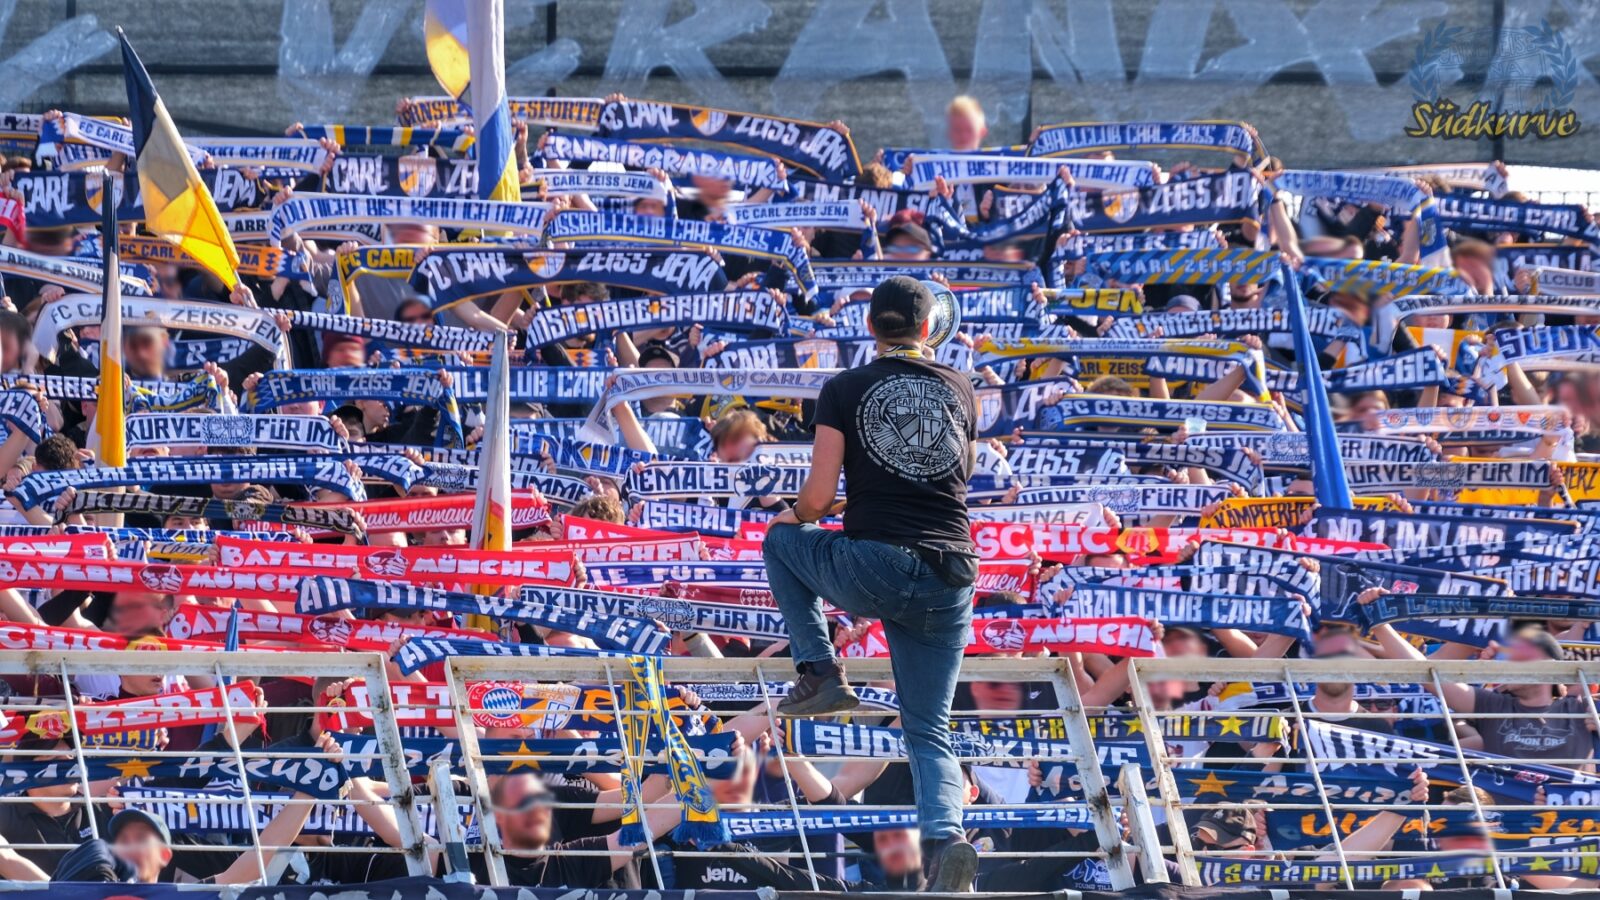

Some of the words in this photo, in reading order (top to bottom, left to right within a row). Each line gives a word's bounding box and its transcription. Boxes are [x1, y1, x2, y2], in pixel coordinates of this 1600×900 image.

[95, 126, 126, 143] CARL
[623, 102, 680, 133] CARL
[735, 115, 800, 147] ZEISS
[1126, 123, 1166, 146] CARL
[1172, 123, 1215, 146] ZEISS
[333, 156, 389, 195] CARL
[446, 161, 479, 194] ZEI
[553, 175, 582, 187] CARL
[586, 175, 619, 188] ZEISS
[624, 177, 654, 190] JENA
[1304, 173, 1338, 191] CARL
[1341, 174, 1384, 193] ZEISS
[17, 173, 75, 218] CARL
[309, 199, 361, 220] NICHT
[366, 199, 401, 218] BIST
[411, 201, 460, 221] KANN
[495, 204, 548, 229] NICHT
[736, 208, 750, 220] FC
[752, 207, 782, 220] CARL
[784, 205, 817, 218] ZEISS
[819, 204, 850, 217] JENA
[1438, 197, 1521, 223] LLCLUB
[1525, 207, 1580, 231] CARL
[672, 216, 716, 245] CARL
[722, 223, 773, 251] ZEISS
[141, 243, 176, 258] CARL
[366, 249, 416, 268] CARL
[453, 251, 515, 283] CARL
[577, 252, 652, 275] ZEISS
[652, 252, 719, 292] JENA
[1120, 259, 1174, 275] CARL
[1184, 259, 1248, 275] ZEISS
[51, 303, 73, 325] FC
[171, 307, 240, 328] ZEISS
[586, 299, 651, 330] ABBE
[962, 291, 1019, 317] CARL
[750, 370, 804, 387] CARL
[1109, 361, 1146, 375] ZEISS
[270, 377, 295, 397] FC
[301, 374, 341, 392] CARL
[349, 374, 393, 392] ZEISS
[1062, 402, 1089, 416] FC
[1095, 402, 1153, 419] CARL
[1164, 403, 1232, 421] ZEISS
[255, 417, 302, 439] FÜR
[1156, 443, 1224, 465] ZEISS
[231, 461, 303, 481] CARL
[1467, 463, 1512, 482] FÜR
[1142, 488, 1187, 507] FÜR
[1008, 509, 1068, 525] JENA
[221, 545, 359, 569] BAYERN
[411, 554, 573, 583] MÜNCHEN
[187, 568, 301, 594] MÜNCH
[375, 580, 447, 609] DIE
[696, 607, 750, 631] FÜR
[1212, 597, 1275, 626] CARL
[1031, 615, 1153, 650] MÜNCH
